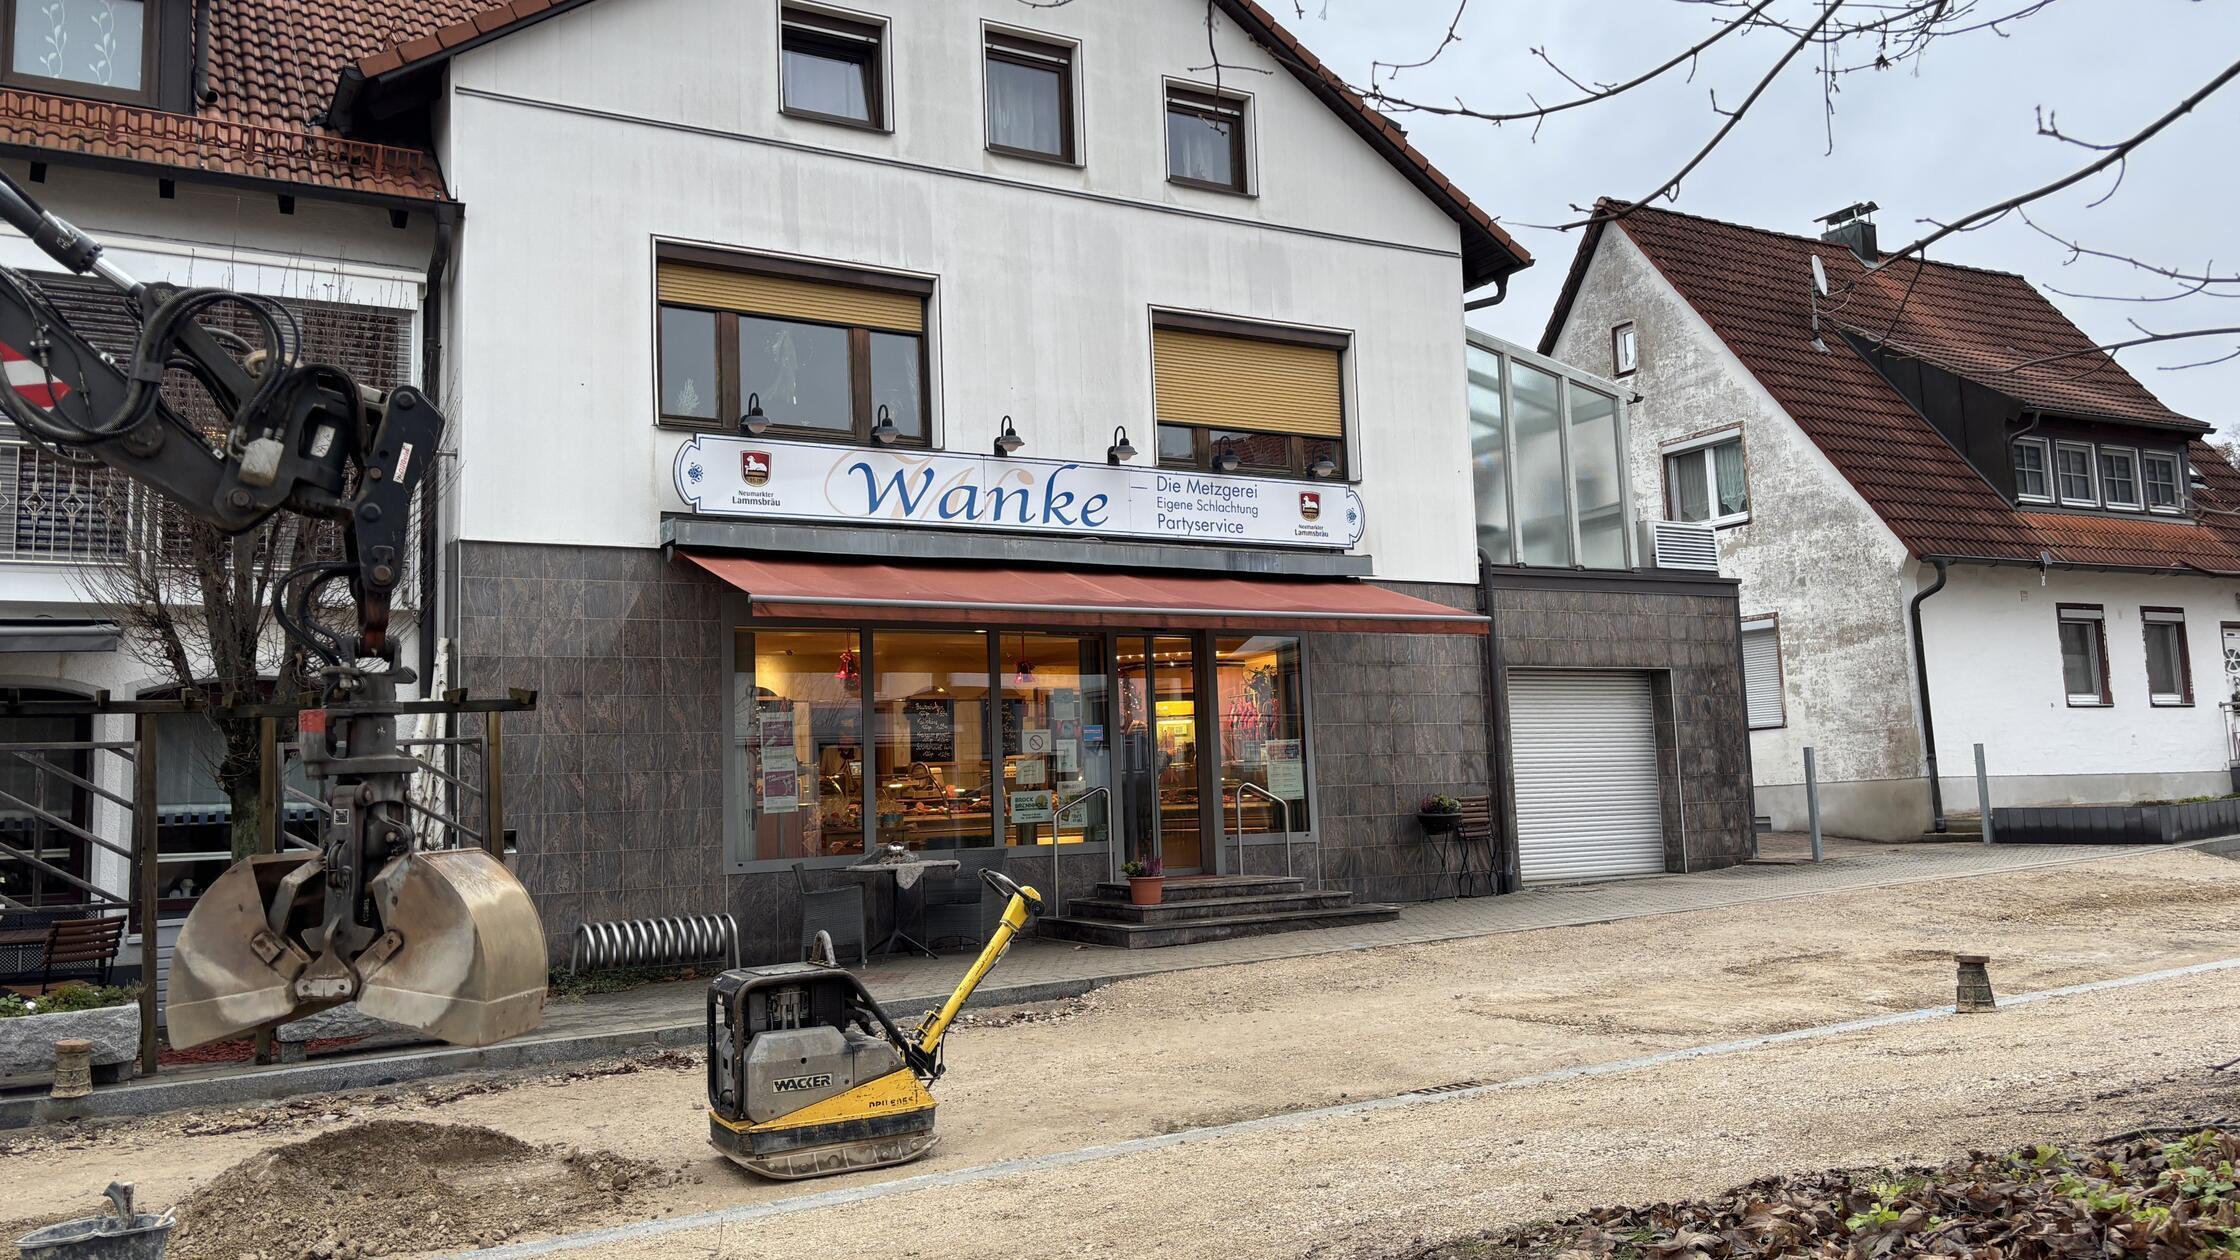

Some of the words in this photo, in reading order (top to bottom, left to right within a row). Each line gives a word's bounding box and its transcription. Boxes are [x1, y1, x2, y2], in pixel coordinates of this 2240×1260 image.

[738, 490, 774, 498] Neumarkter
[848, 463, 1109, 527] Wanke
[1156, 475, 1181, 493] Die
[1186, 478, 1258, 501] Metzgerei
[732, 496, 781, 506] Lammsbräu
[1156, 496, 1193, 512] Eigene
[1197, 499, 1259, 518] Schlachtung
[1157, 513, 1244, 535] Partyservice
[1294, 529, 1329, 537] Lammsbräu
[774, 1075, 831, 1092] WACKER
